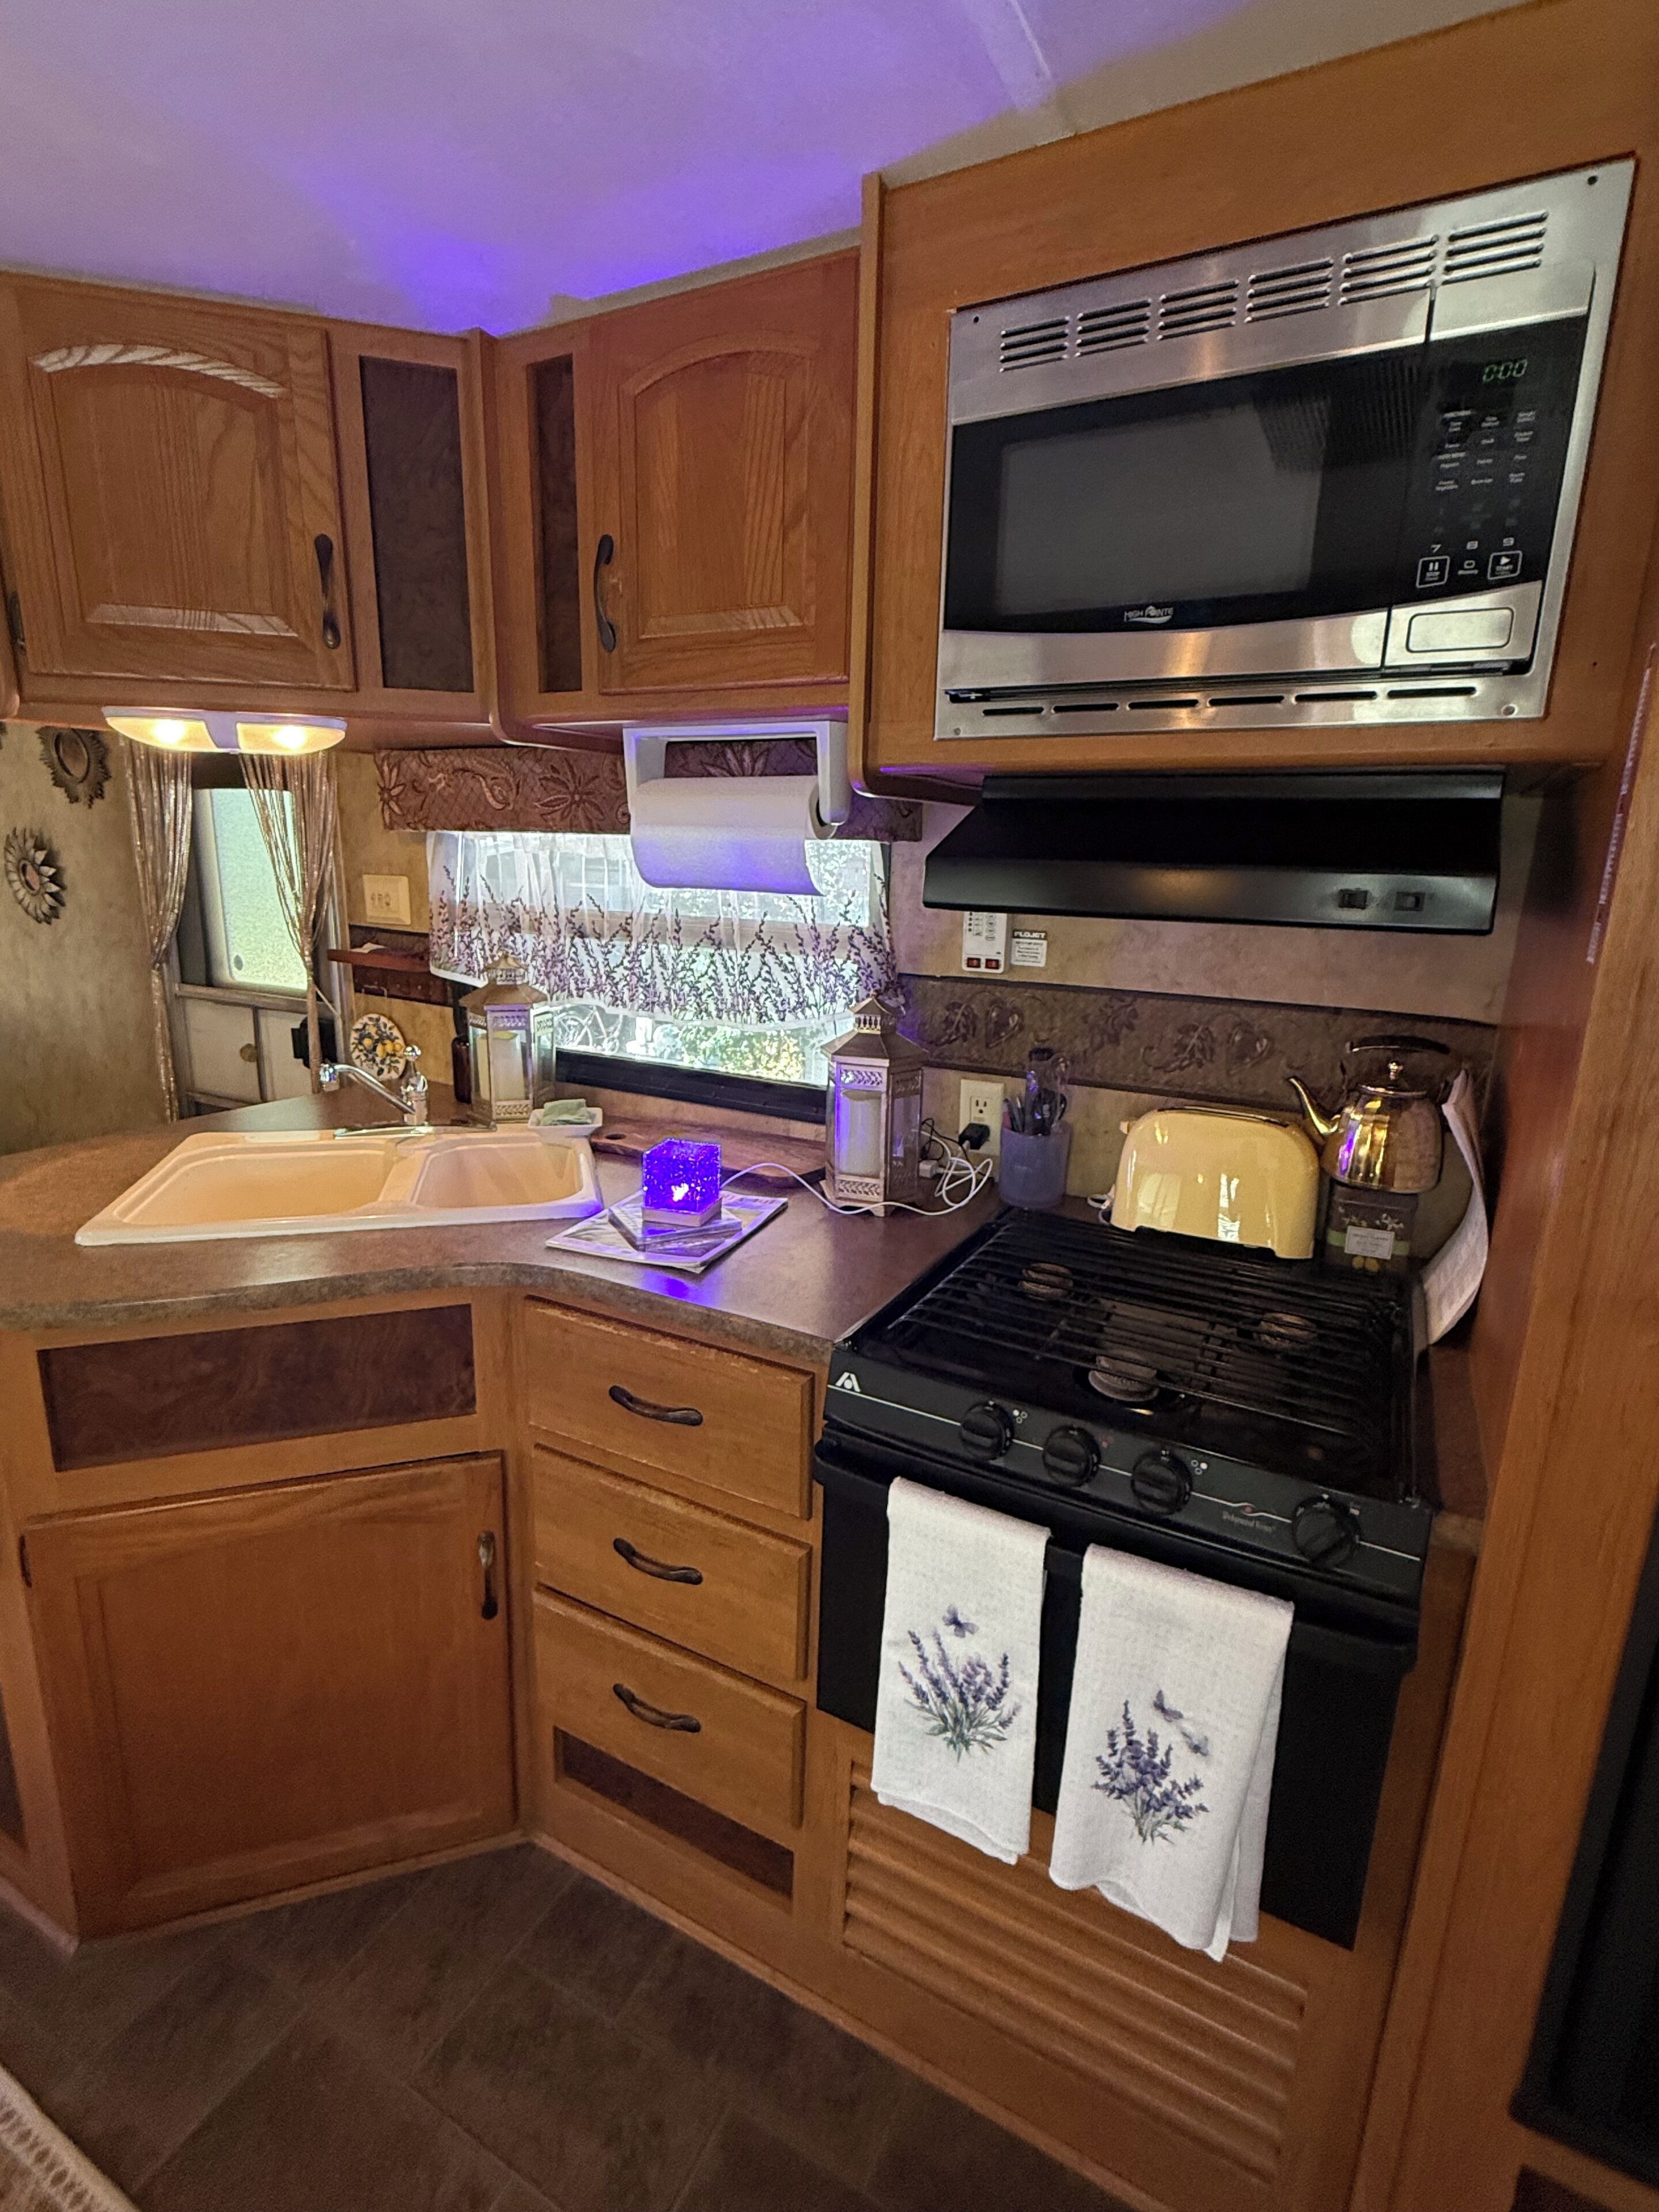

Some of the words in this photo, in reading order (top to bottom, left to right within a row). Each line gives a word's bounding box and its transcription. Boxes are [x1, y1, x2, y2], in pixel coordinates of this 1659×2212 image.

[1430, 544, 1442, 553] 7
[1124, 611, 1143, 622] HIGH
[1145, 605, 1174, 618] POINTE
